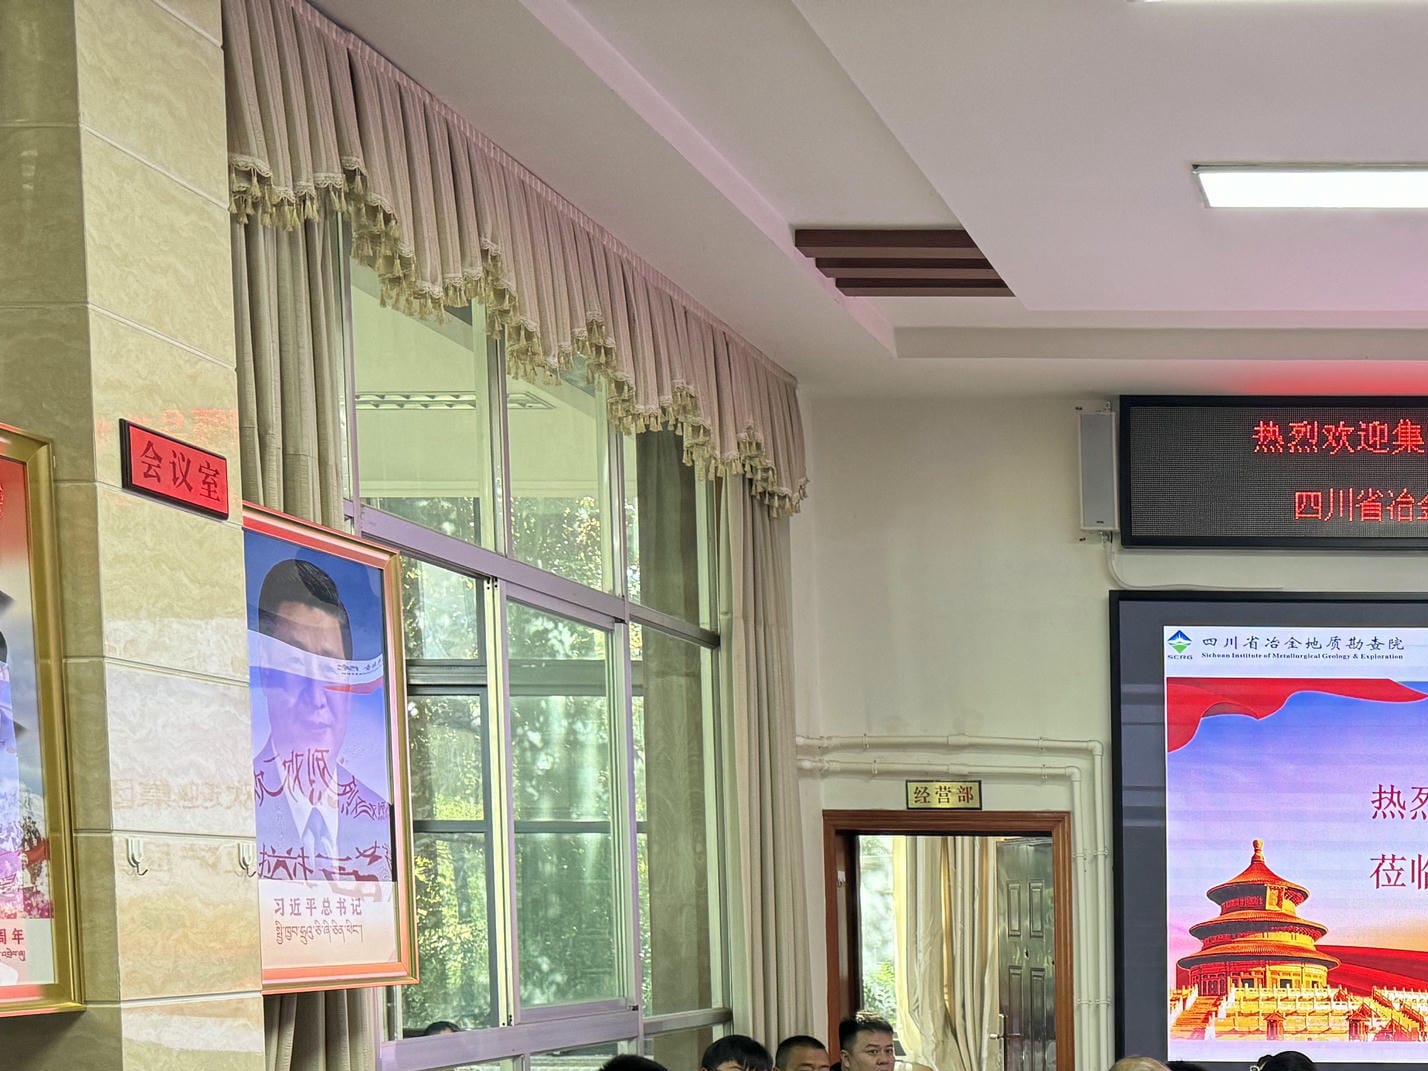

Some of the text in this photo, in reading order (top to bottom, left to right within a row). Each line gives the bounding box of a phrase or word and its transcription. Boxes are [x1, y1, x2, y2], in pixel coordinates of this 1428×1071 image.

[140, 440, 221, 502] 会议室
[913, 785, 974, 804] 经营部
[273, 897, 362, 916] 习近平总书记
